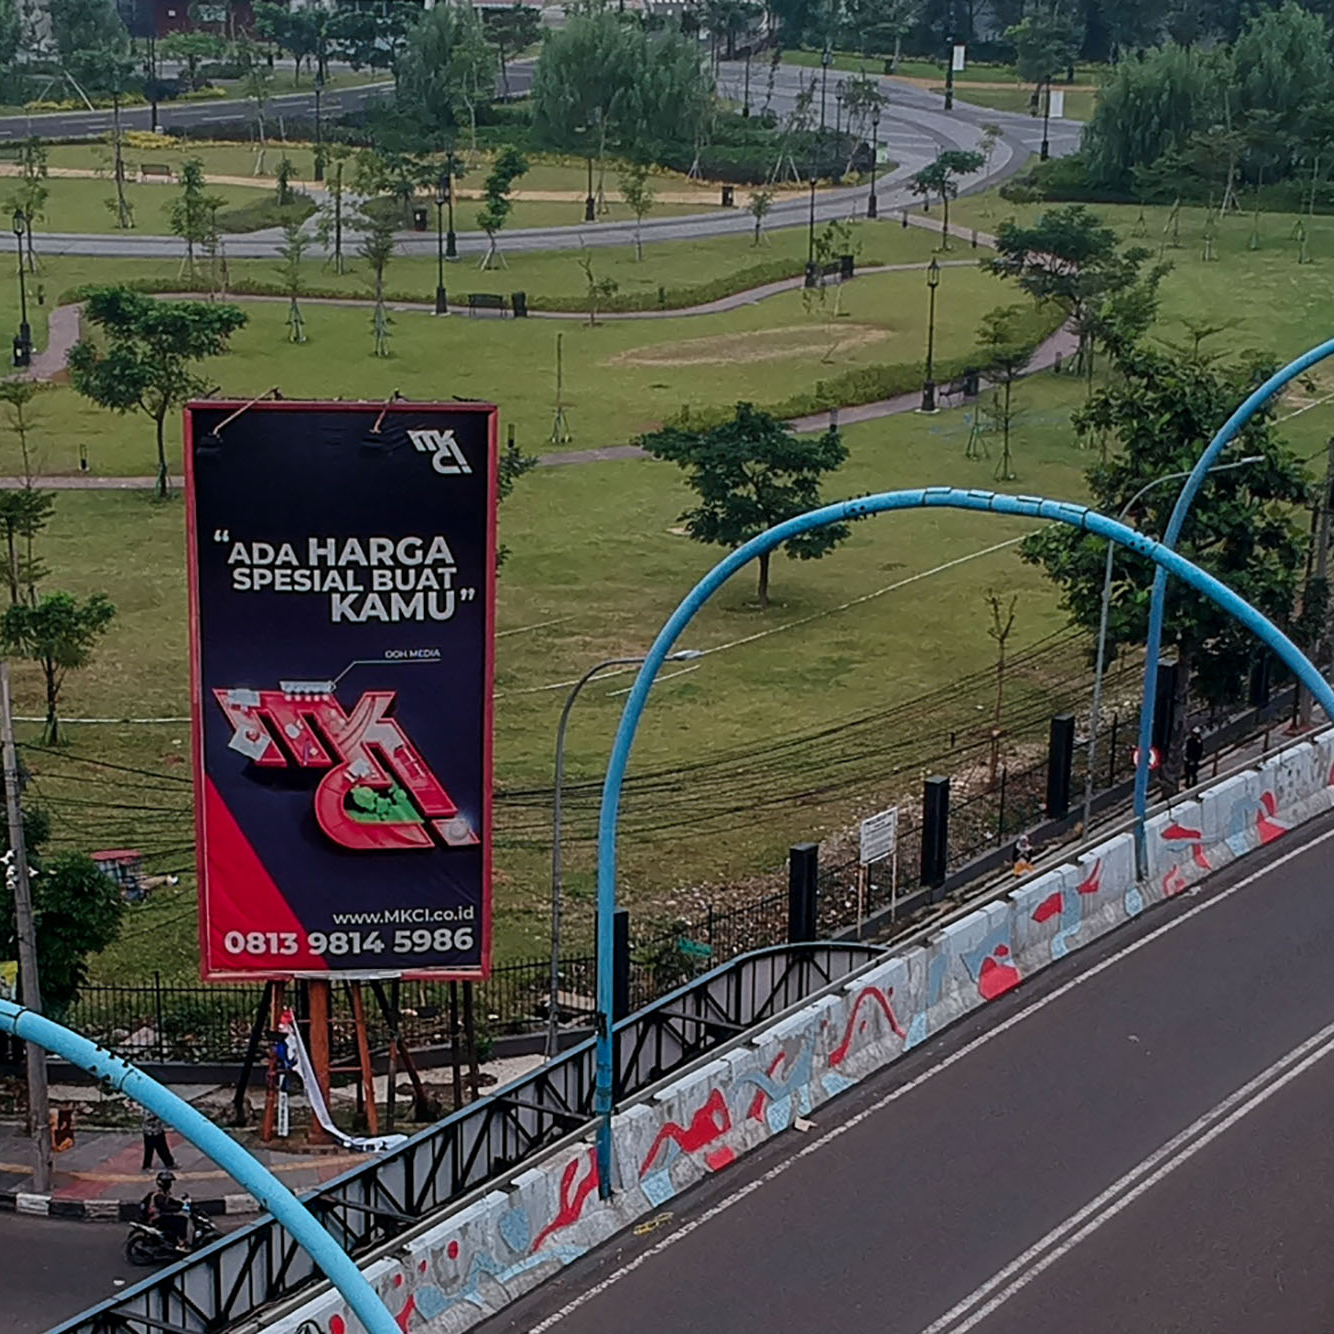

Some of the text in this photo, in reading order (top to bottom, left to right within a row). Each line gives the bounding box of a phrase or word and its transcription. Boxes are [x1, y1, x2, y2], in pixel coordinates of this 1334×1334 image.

[308, 536, 455, 567] HARGA
[233, 567, 457, 592] SPESIAL BUAT
[333, 905, 474, 925] www.MKCI.co.id
[224, 927, 474, 955] 0813 9814 5986
